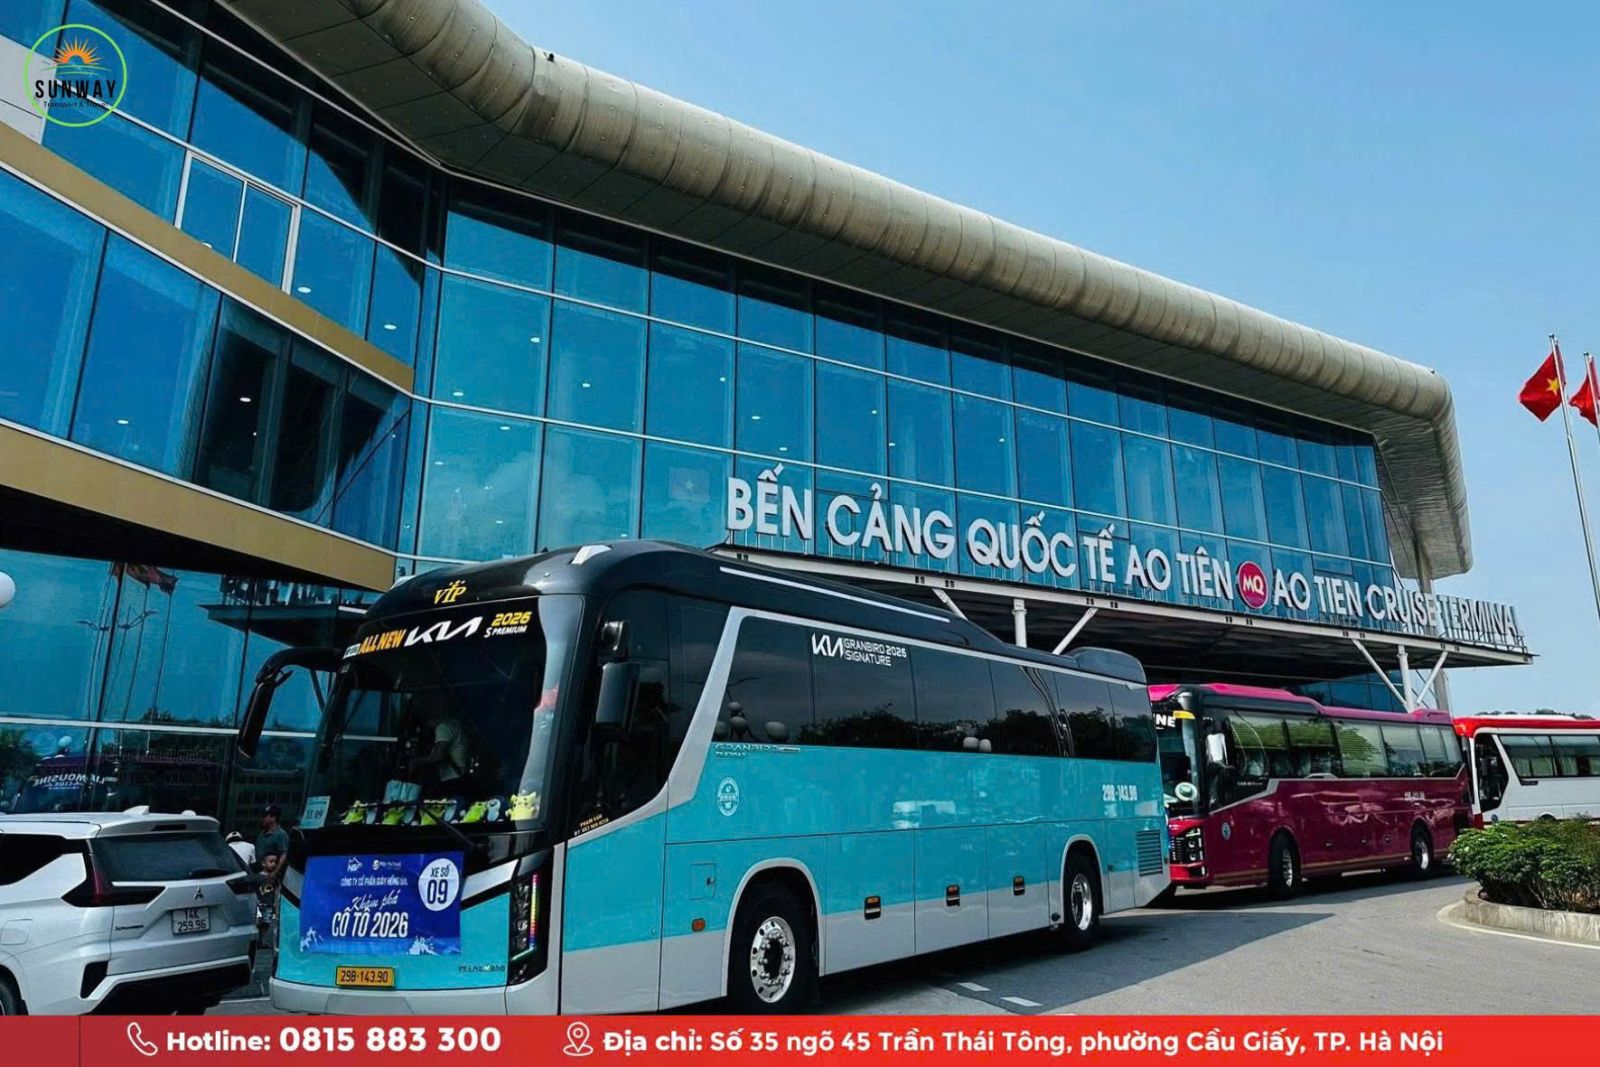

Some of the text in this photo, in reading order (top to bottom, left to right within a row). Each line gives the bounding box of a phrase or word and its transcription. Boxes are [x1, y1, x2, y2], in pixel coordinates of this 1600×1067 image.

[727, 463, 1233, 600] BẾN CẢNG QUỐC TẾ AO TIÊN
[434, 586, 467, 604] VIP
[1242, 573, 1265, 596] MQ
[1273, 568, 1311, 611] AO
[1313, 576, 1363, 617] TIEN
[1366, 585, 1437, 628] CRUISE
[491, 612, 532, 627] 2026
[492, 625, 528, 636] PREMIUM
[359, 637, 378, 654] ALL
[377, 630, 406, 650] NEW
[844, 638, 907, 658] GRANBIRD 2026
[844, 650, 892, 666] SIGNATURE
[430, 864, 450, 877] XE SỐ
[350, 889, 401, 912] Khám phá
[427, 879, 448, 904] 09
[331, 907, 409, 937] CÔ TÔ 2026
